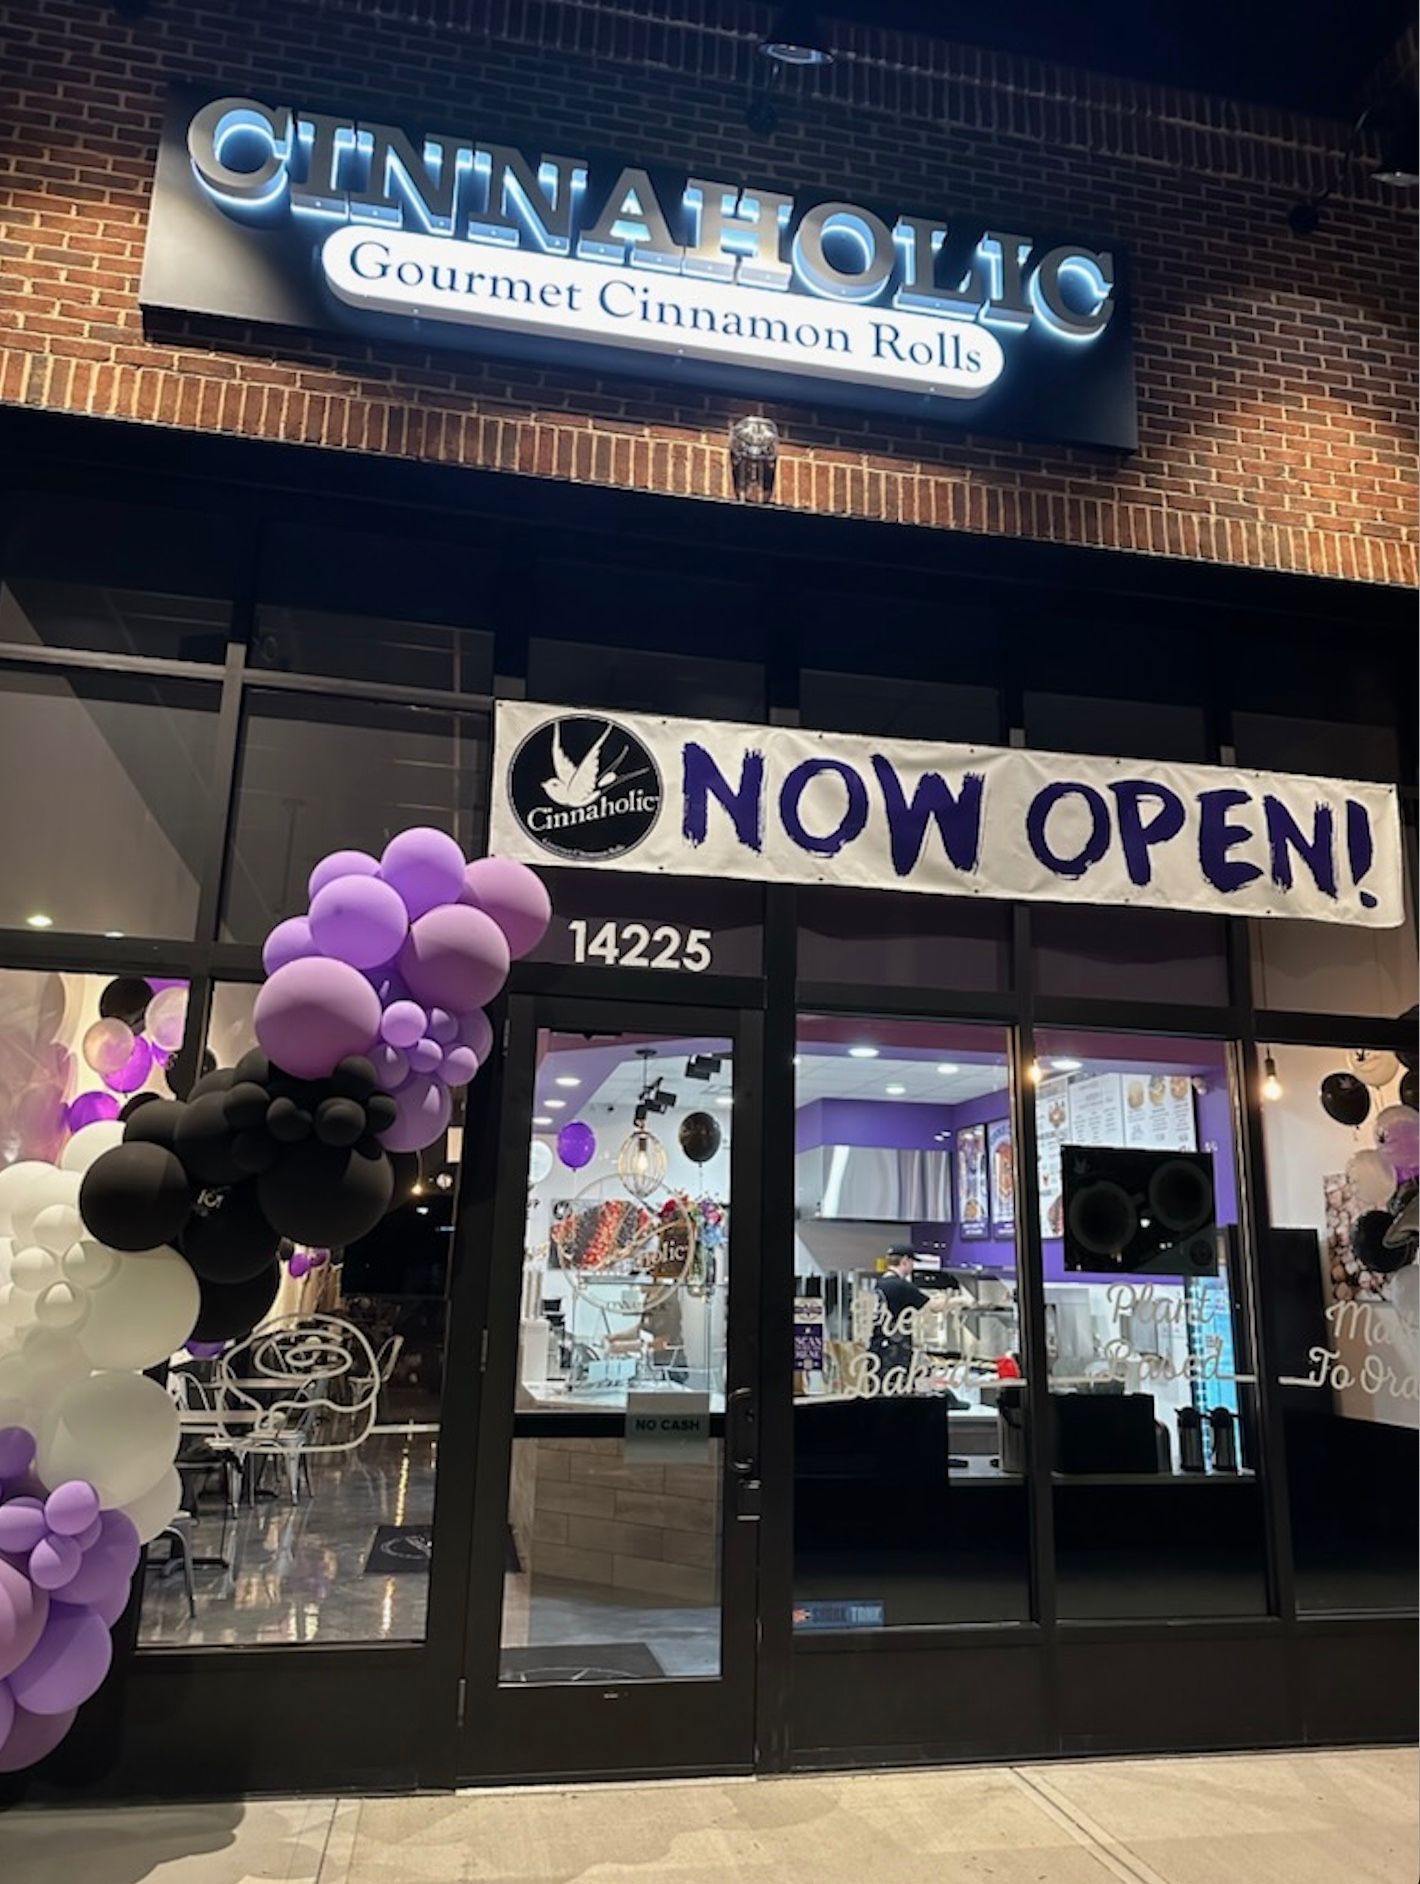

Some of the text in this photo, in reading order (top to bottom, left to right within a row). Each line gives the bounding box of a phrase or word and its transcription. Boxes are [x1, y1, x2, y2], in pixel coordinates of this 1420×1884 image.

[187, 97, 1114, 337] CINNAHOLIC
[349, 240, 983, 374] Gourmet Cinnamon Rolls
[526, 788, 657, 832] Cinnaholic
[681, 741, 1378, 908] NOW OPEN!
[567, 919, 712, 973] 14225
[635, 1418, 700, 1432] NO CASH
